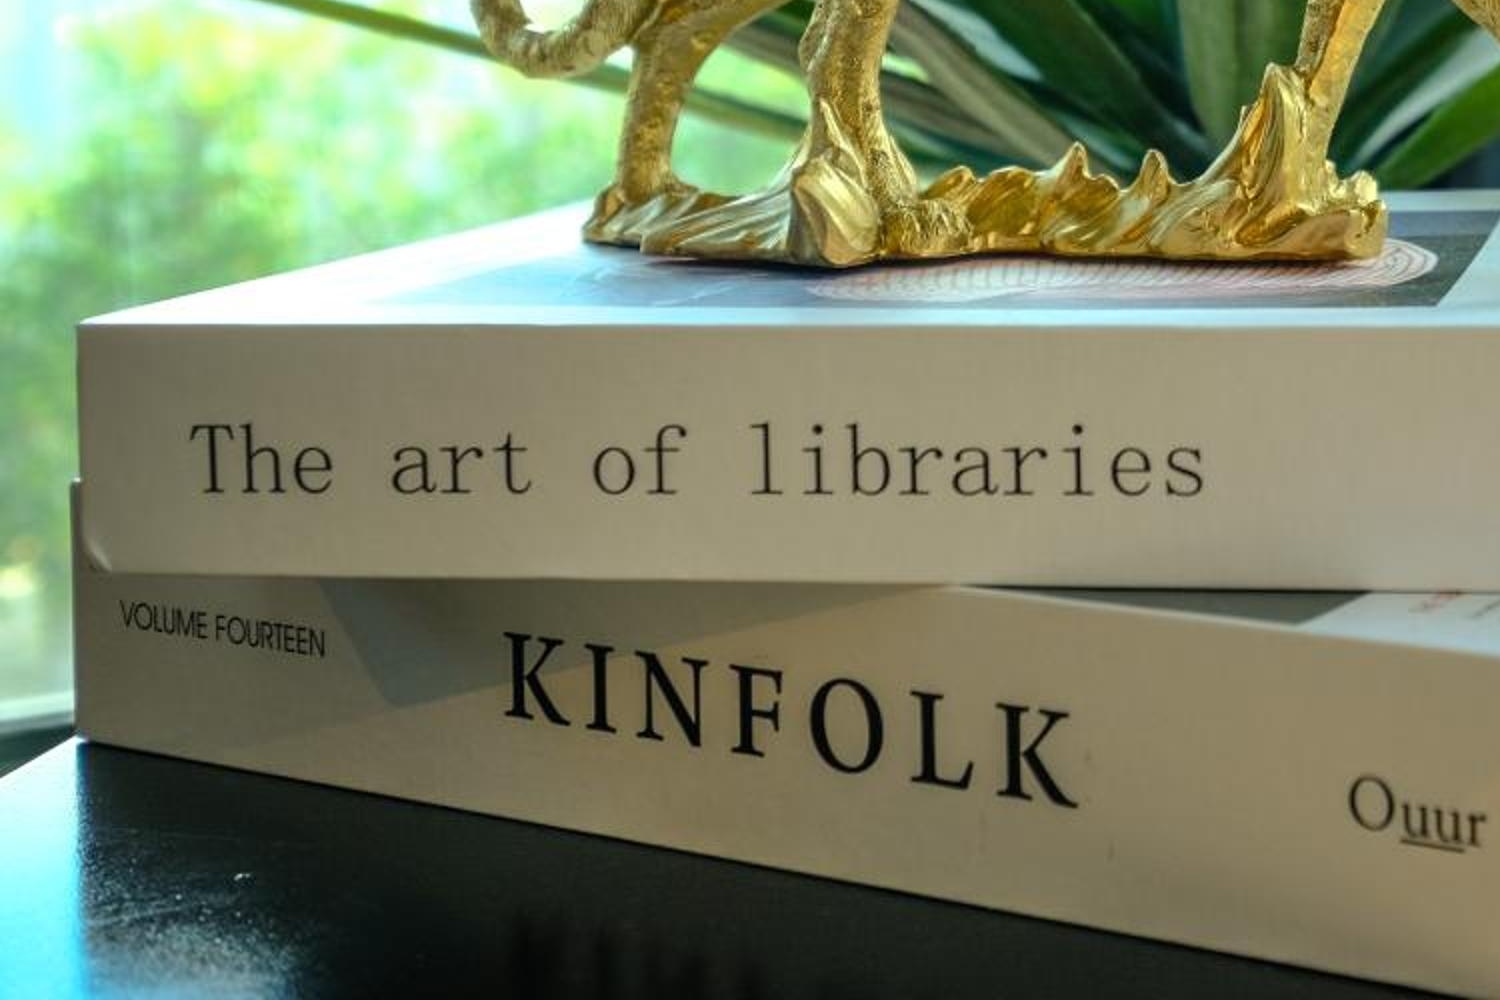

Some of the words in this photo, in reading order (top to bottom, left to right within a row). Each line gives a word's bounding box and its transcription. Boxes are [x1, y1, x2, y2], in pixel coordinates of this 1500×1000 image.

[189, 421, 334, 495] The
[390, 431, 532, 496] art
[591, 423, 688, 496] of
[749, 420, 1204, 498] libraries
[119, 599, 209, 641] VOLUME
[214, 613, 327, 658] FOURTEEN
[502, 631, 1078, 809] KINFOLK
[1347, 774, 1488, 852] Ouur
